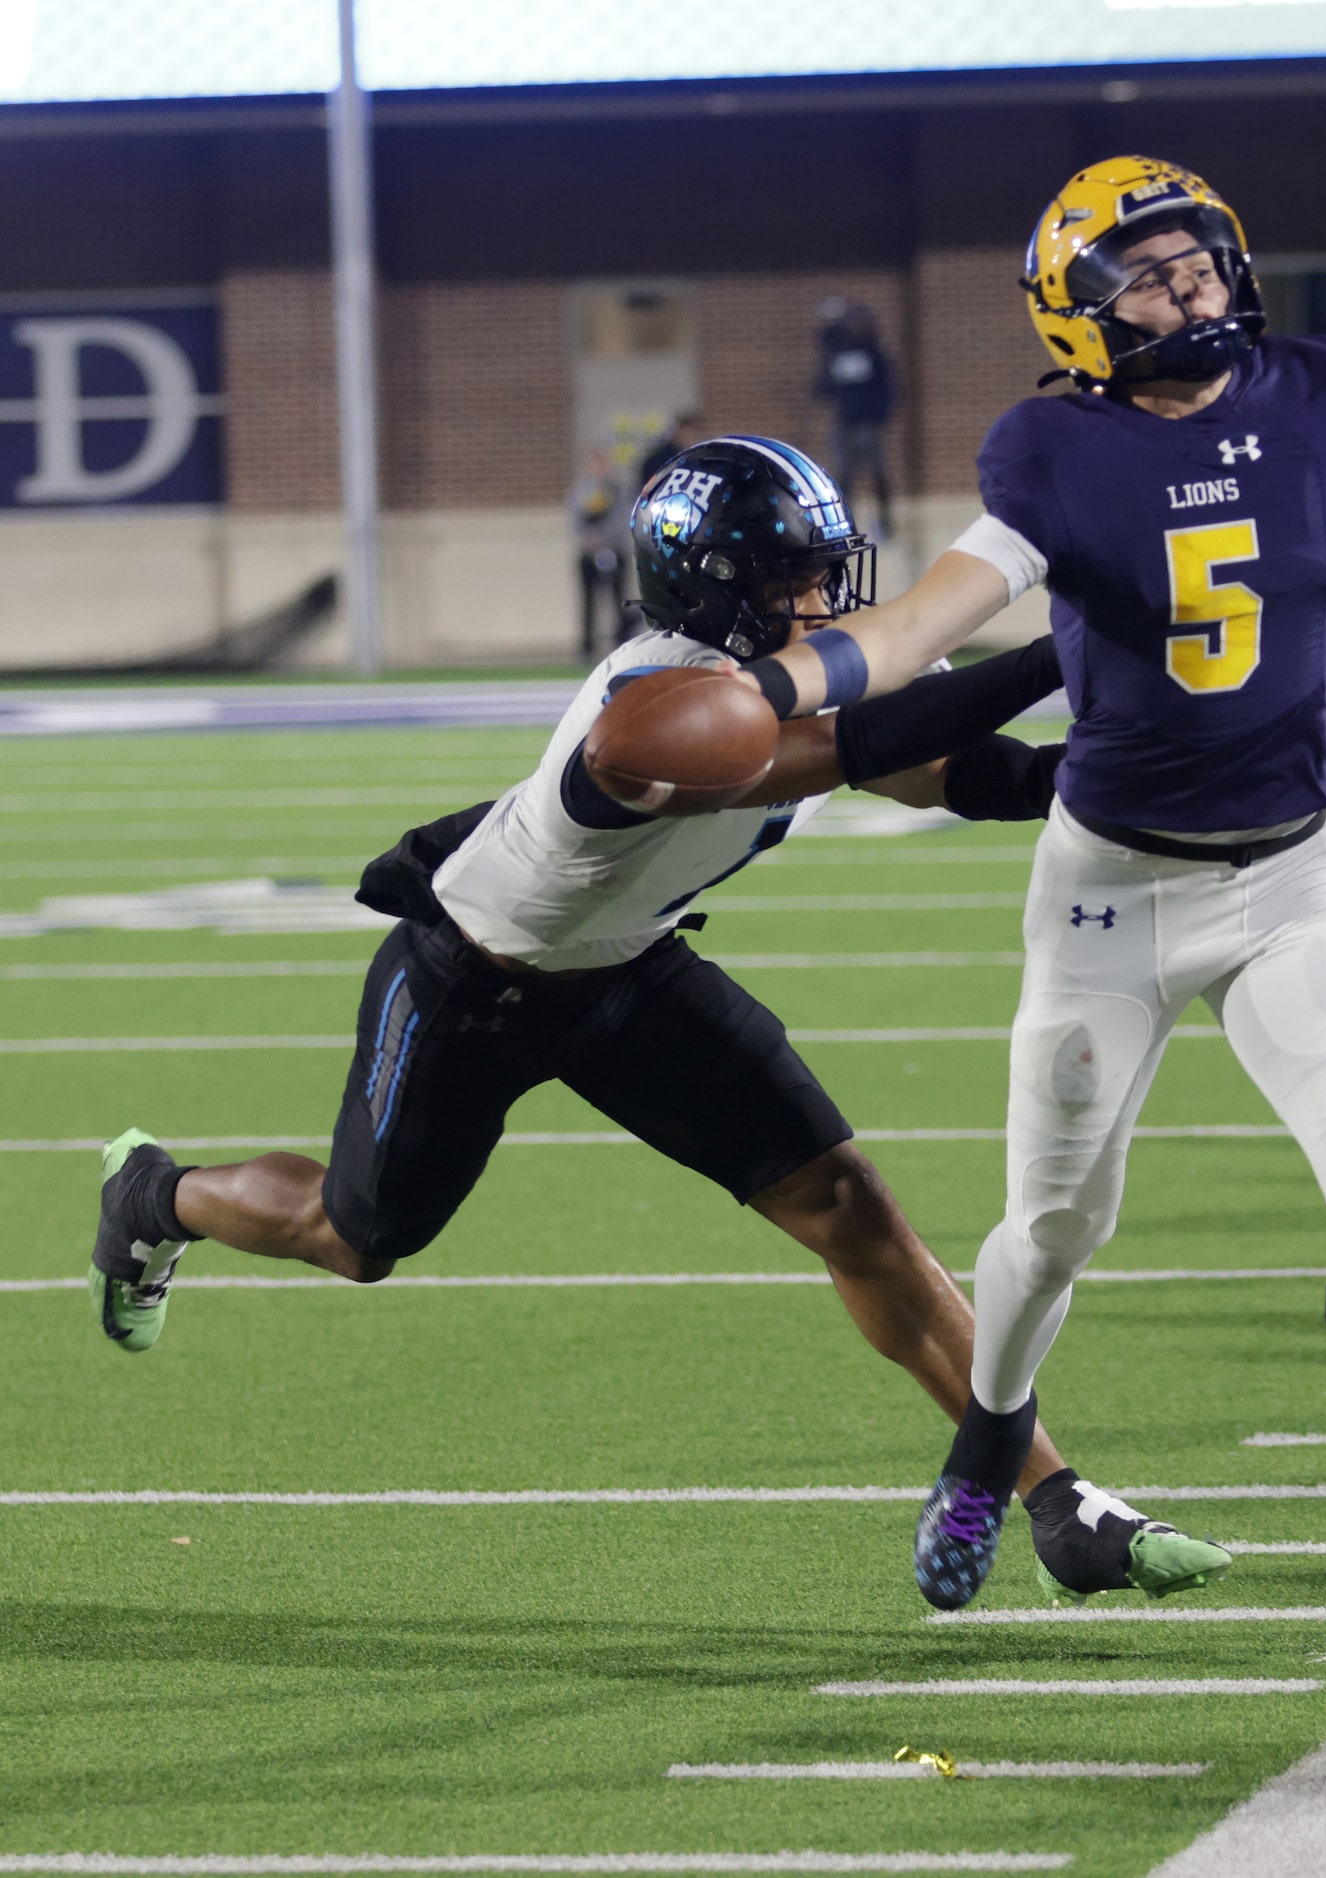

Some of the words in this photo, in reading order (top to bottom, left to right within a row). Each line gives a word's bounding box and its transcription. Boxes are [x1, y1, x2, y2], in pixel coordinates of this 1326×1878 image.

[12, 316, 200, 503] D
[656, 468, 723, 512] RH
[1166, 478, 1240, 509] LIONS
[1163, 518, 1264, 695] 5
